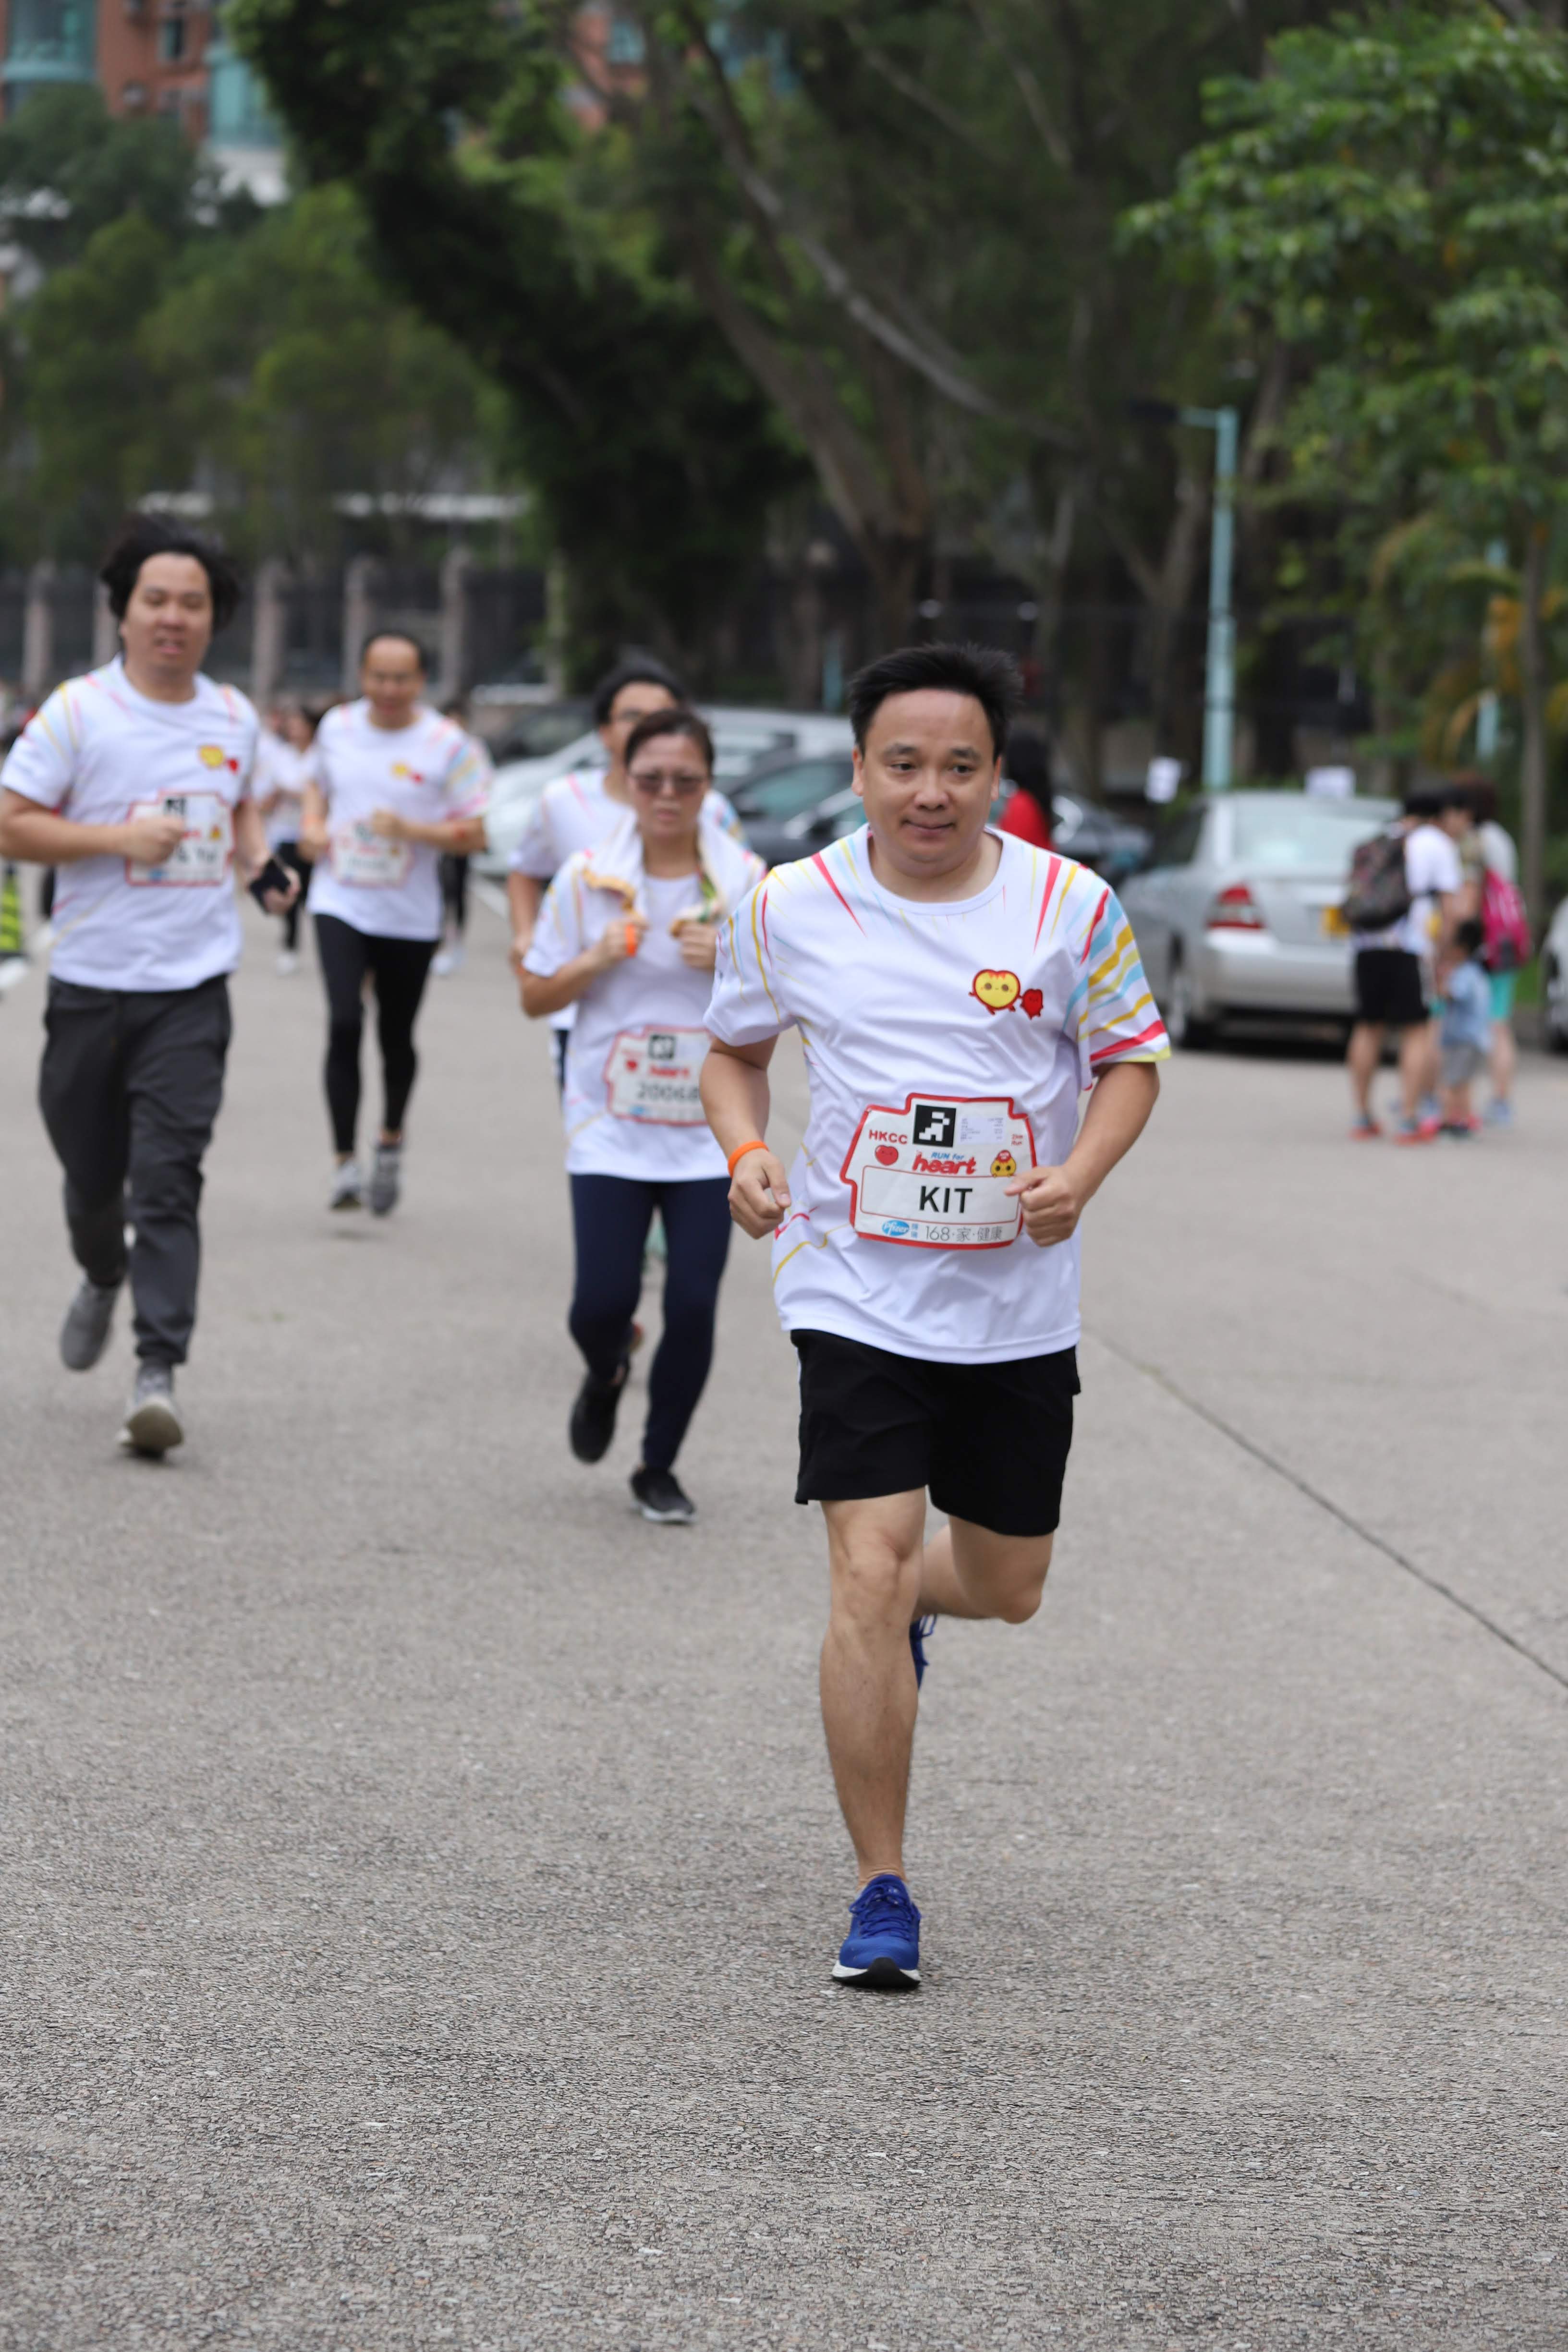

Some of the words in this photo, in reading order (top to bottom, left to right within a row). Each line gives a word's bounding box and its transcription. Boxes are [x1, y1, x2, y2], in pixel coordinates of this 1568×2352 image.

[868, 1129, 908, 1144] HKCC
[912, 1153, 976, 1175] heart
[919, 1186, 972, 1213] KIT
[883, 1223, 909, 1236] Pfizer
